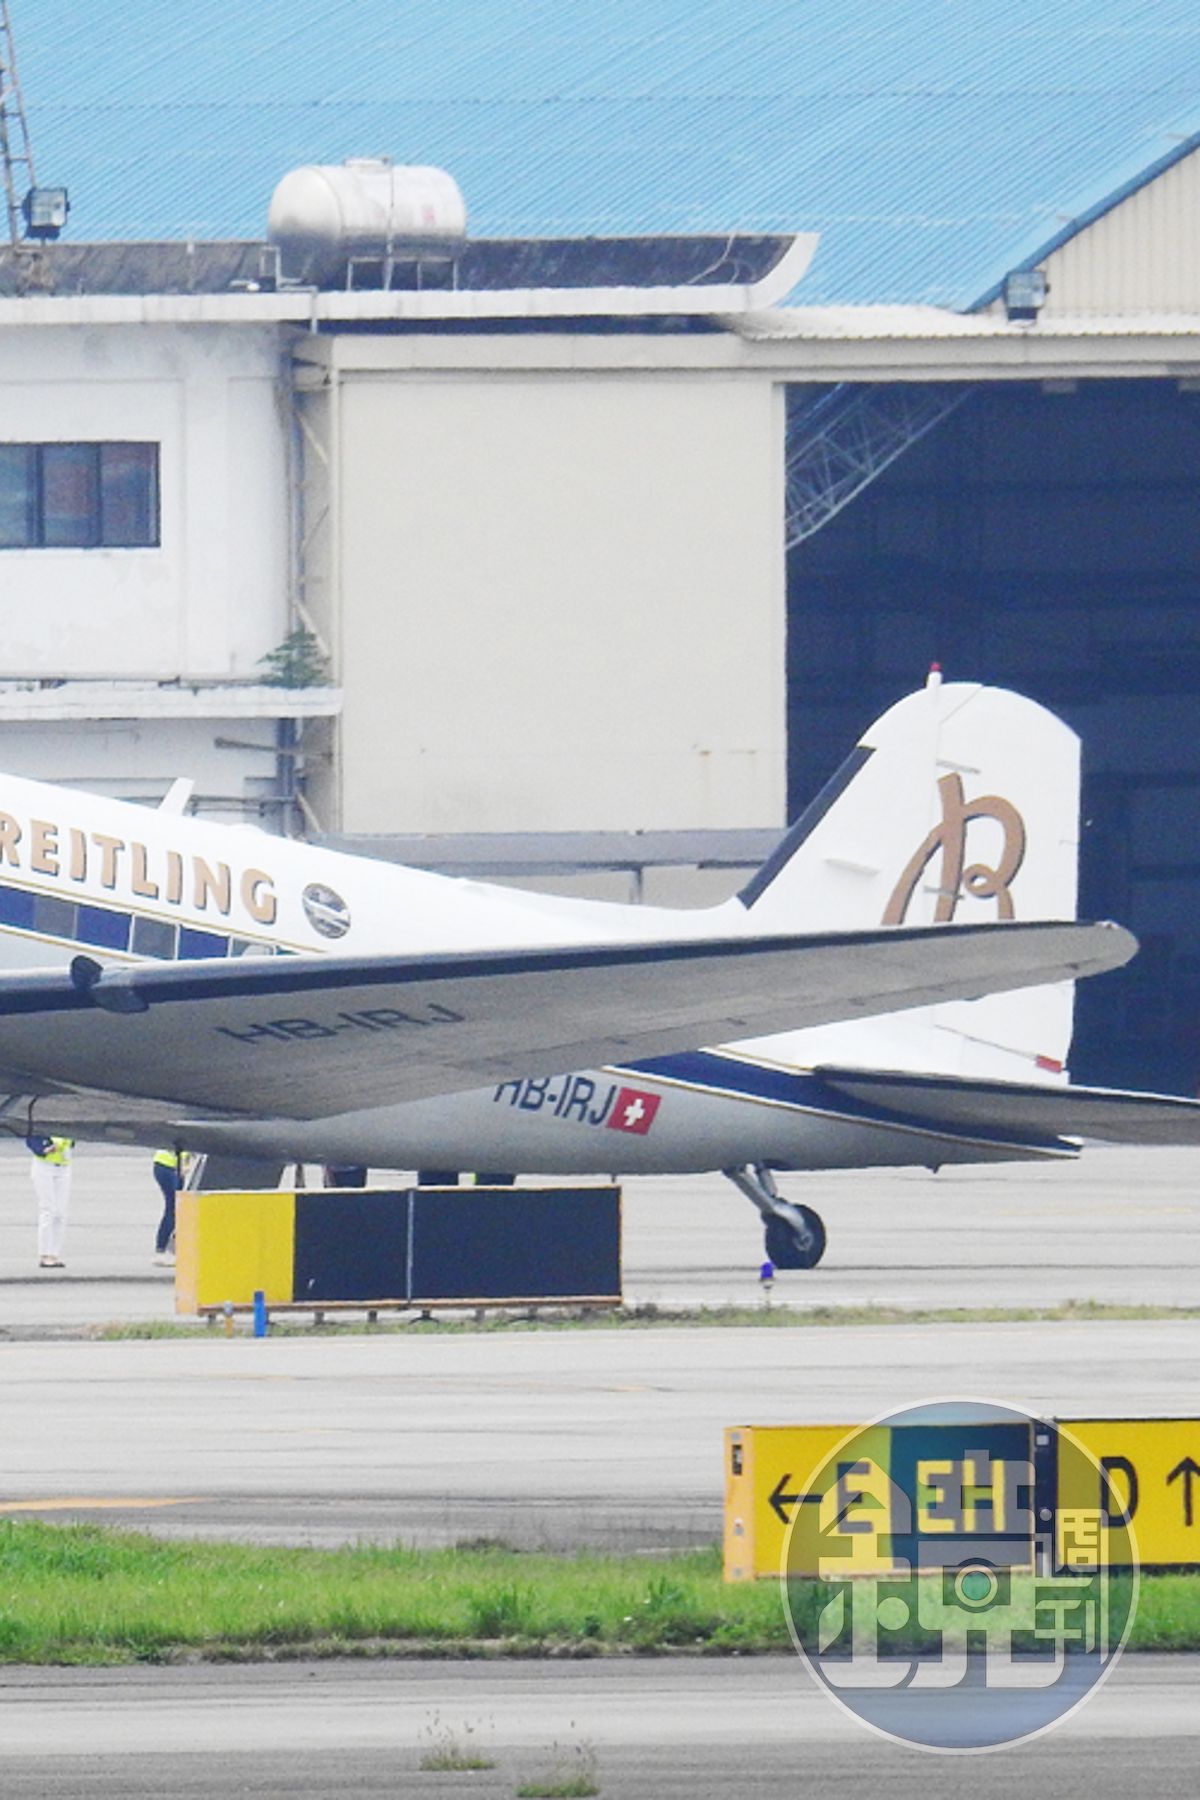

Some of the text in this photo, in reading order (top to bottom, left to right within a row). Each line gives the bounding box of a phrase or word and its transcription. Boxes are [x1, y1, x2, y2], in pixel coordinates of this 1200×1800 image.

[215, 1002, 466, 1044] HB-IRJ
[916, 1459, 1006, 1533] EH
[1099, 1455, 1139, 1529] D
